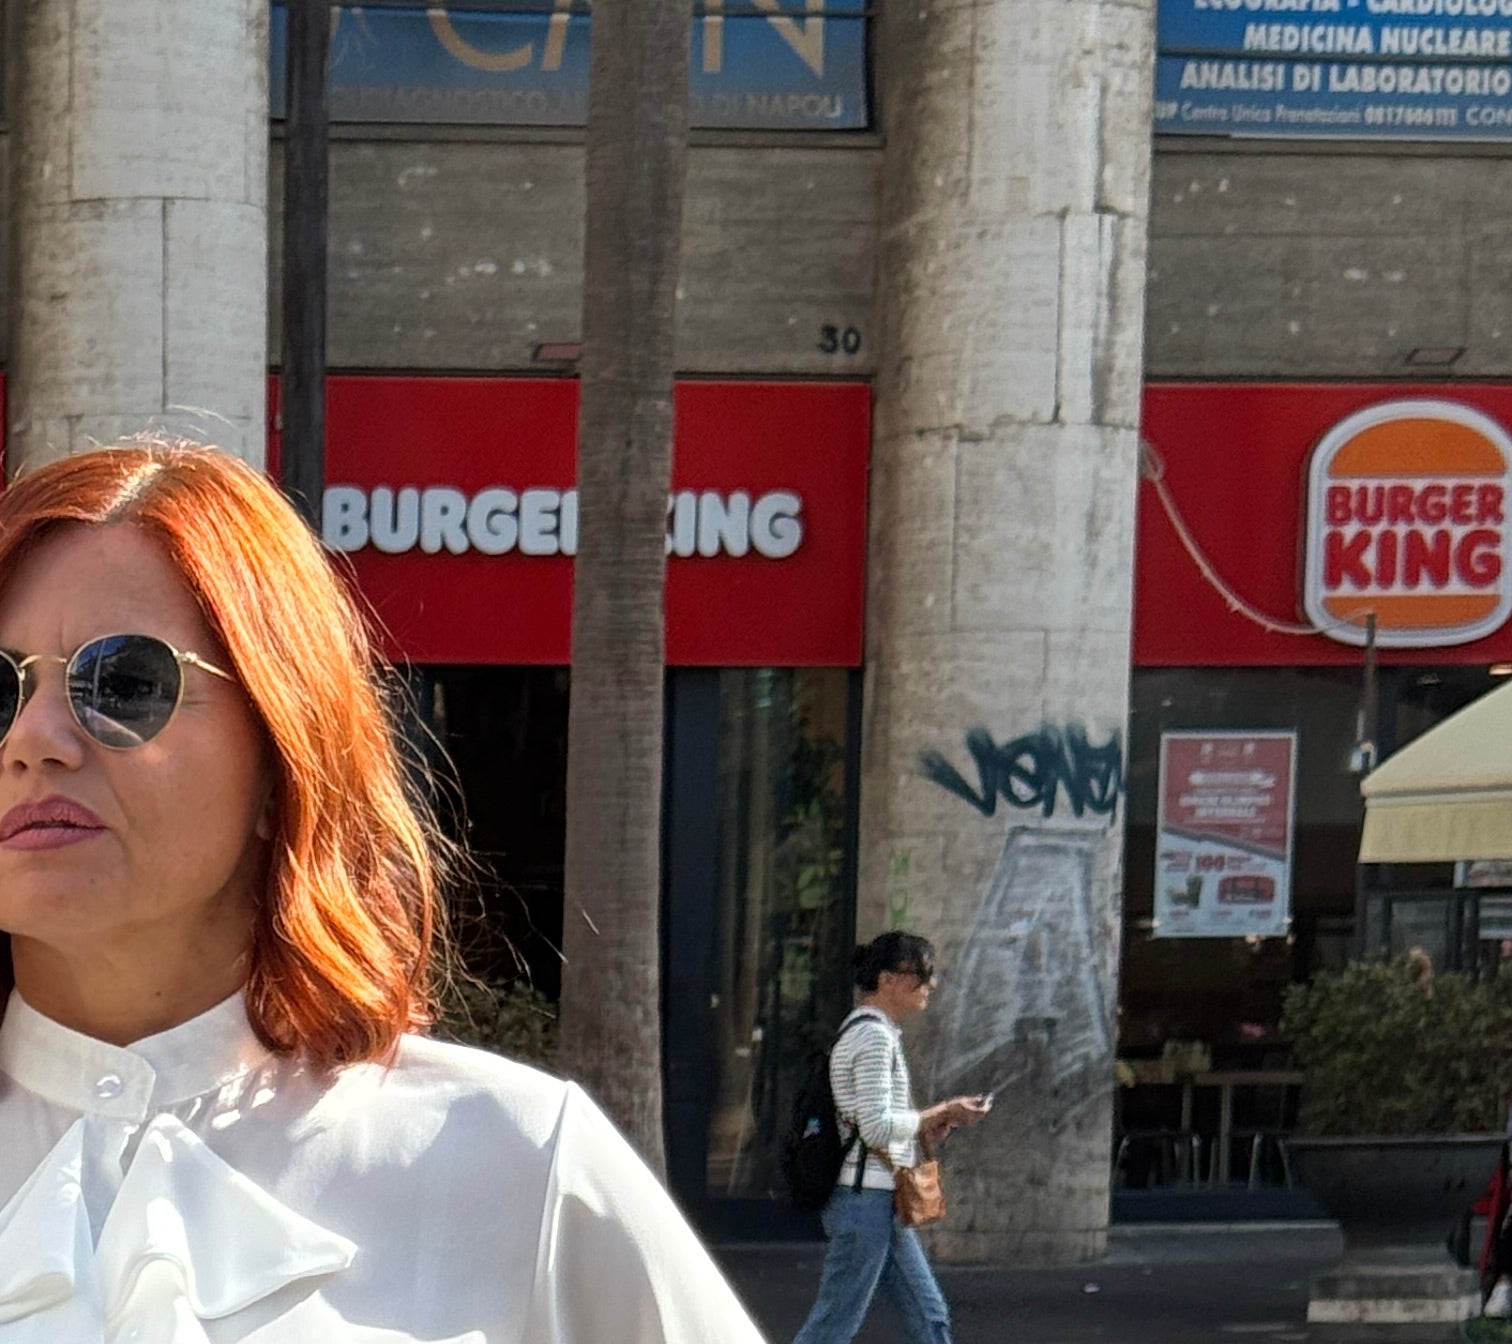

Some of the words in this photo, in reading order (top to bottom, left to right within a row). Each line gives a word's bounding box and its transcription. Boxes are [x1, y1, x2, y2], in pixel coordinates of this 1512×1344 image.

[1243, 23, 1374, 53] MEDICINA
[1380, 28, 1511, 56] NUCLEARE
[1181, 61, 1285, 90] ANALISI
[1292, 65, 1321, 92] DI
[1329, 66, 1511, 95] LABORATORIO
[817, 324, 861, 354] 30
[665, 490, 802, 558] ING
[1326, 484, 1504, 527] BURGER
[1324, 529, 1502, 590] KING
